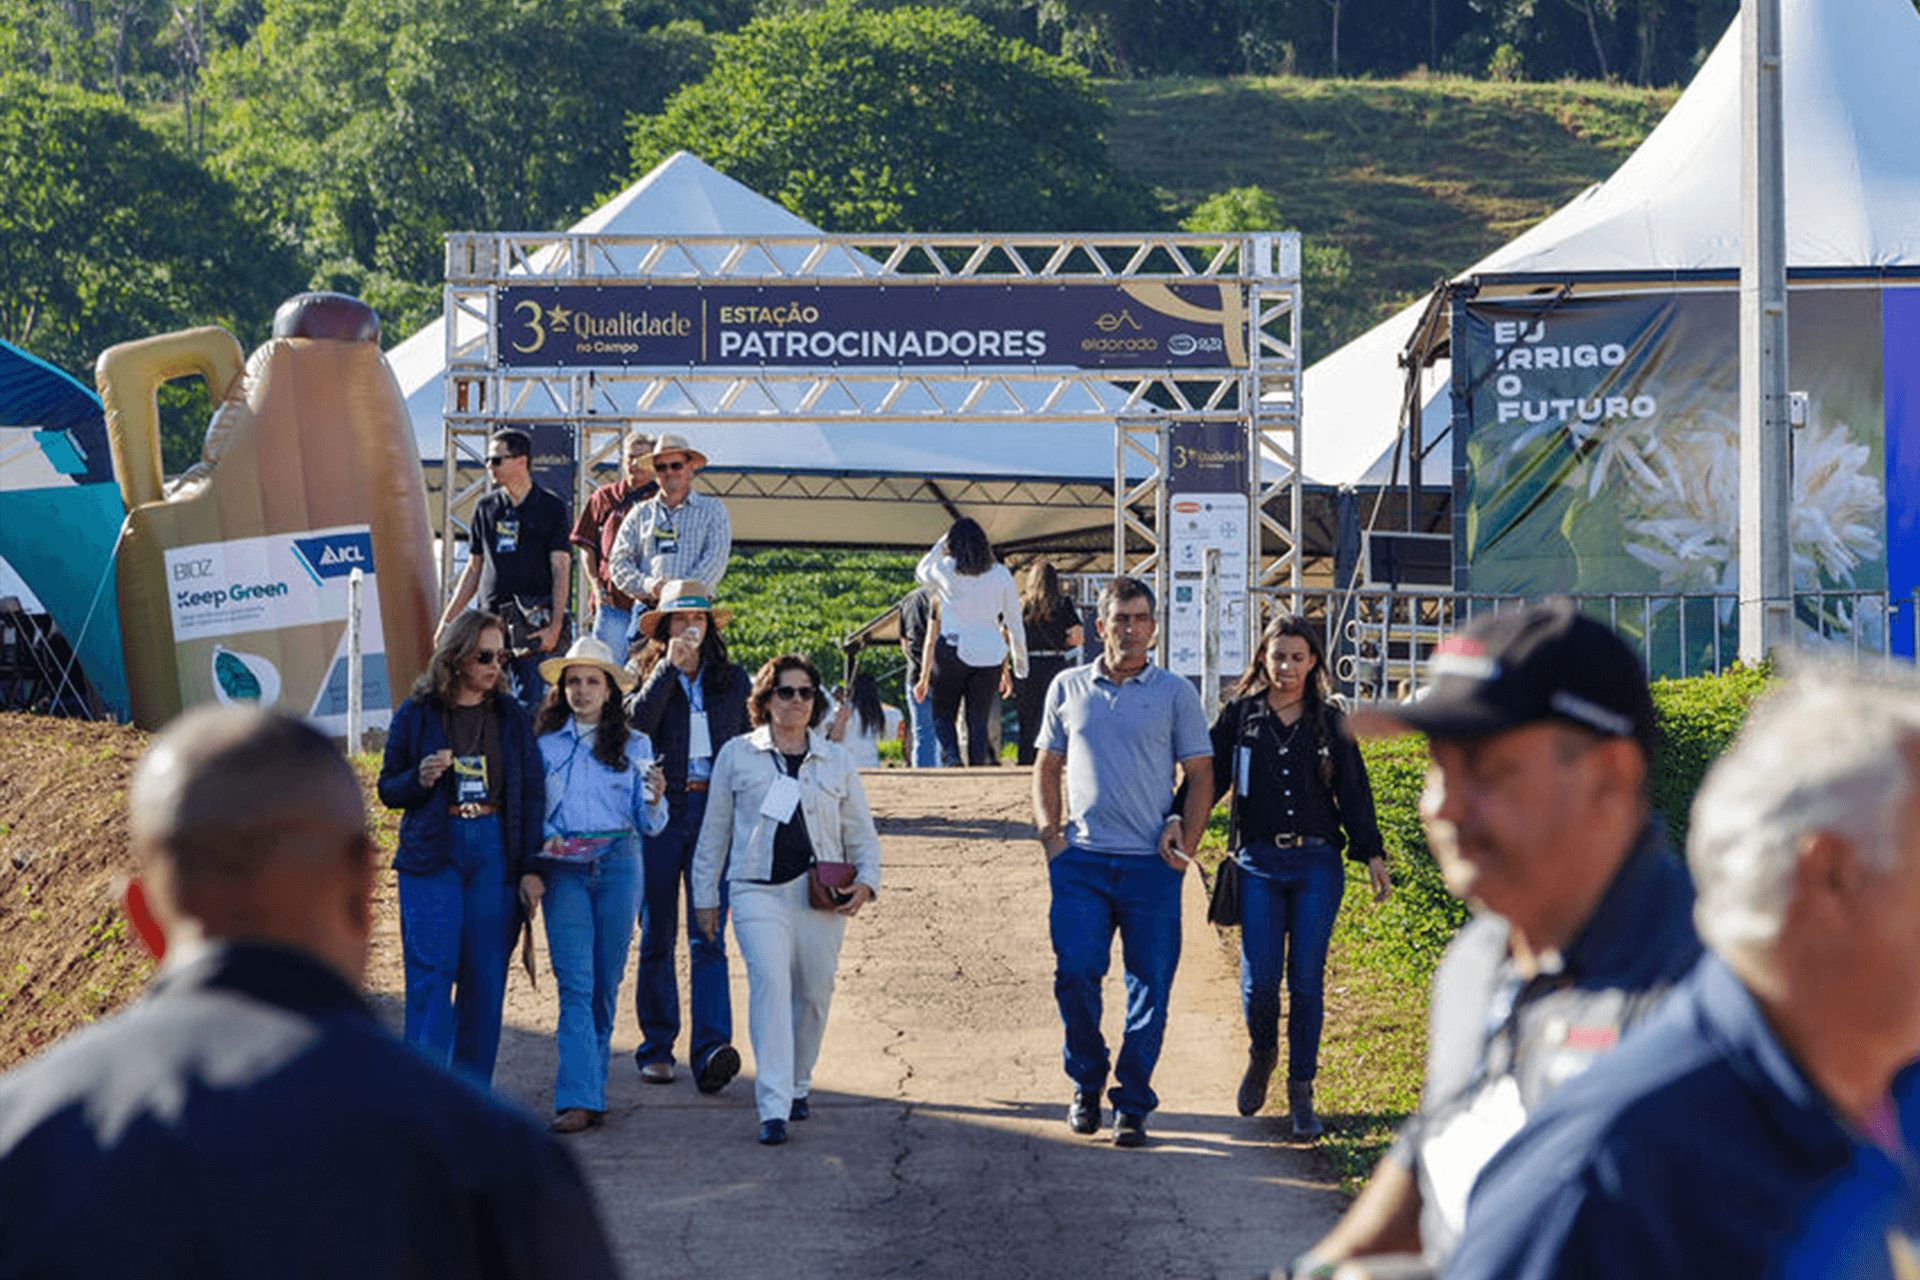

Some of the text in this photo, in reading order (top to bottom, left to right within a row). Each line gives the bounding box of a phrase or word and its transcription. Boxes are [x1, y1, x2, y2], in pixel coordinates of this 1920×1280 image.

[574, 310, 692, 340] Qualidade
[720, 301, 819, 328] ESTAÇÃO
[720, 330, 1047, 358] PATROCINADORES
[1494, 320, 1545, 344] EU
[1496, 374, 1522, 397] O
[1497, 395, 1656, 423] FUTURO
[177, 582, 288, 609] Keep Green
